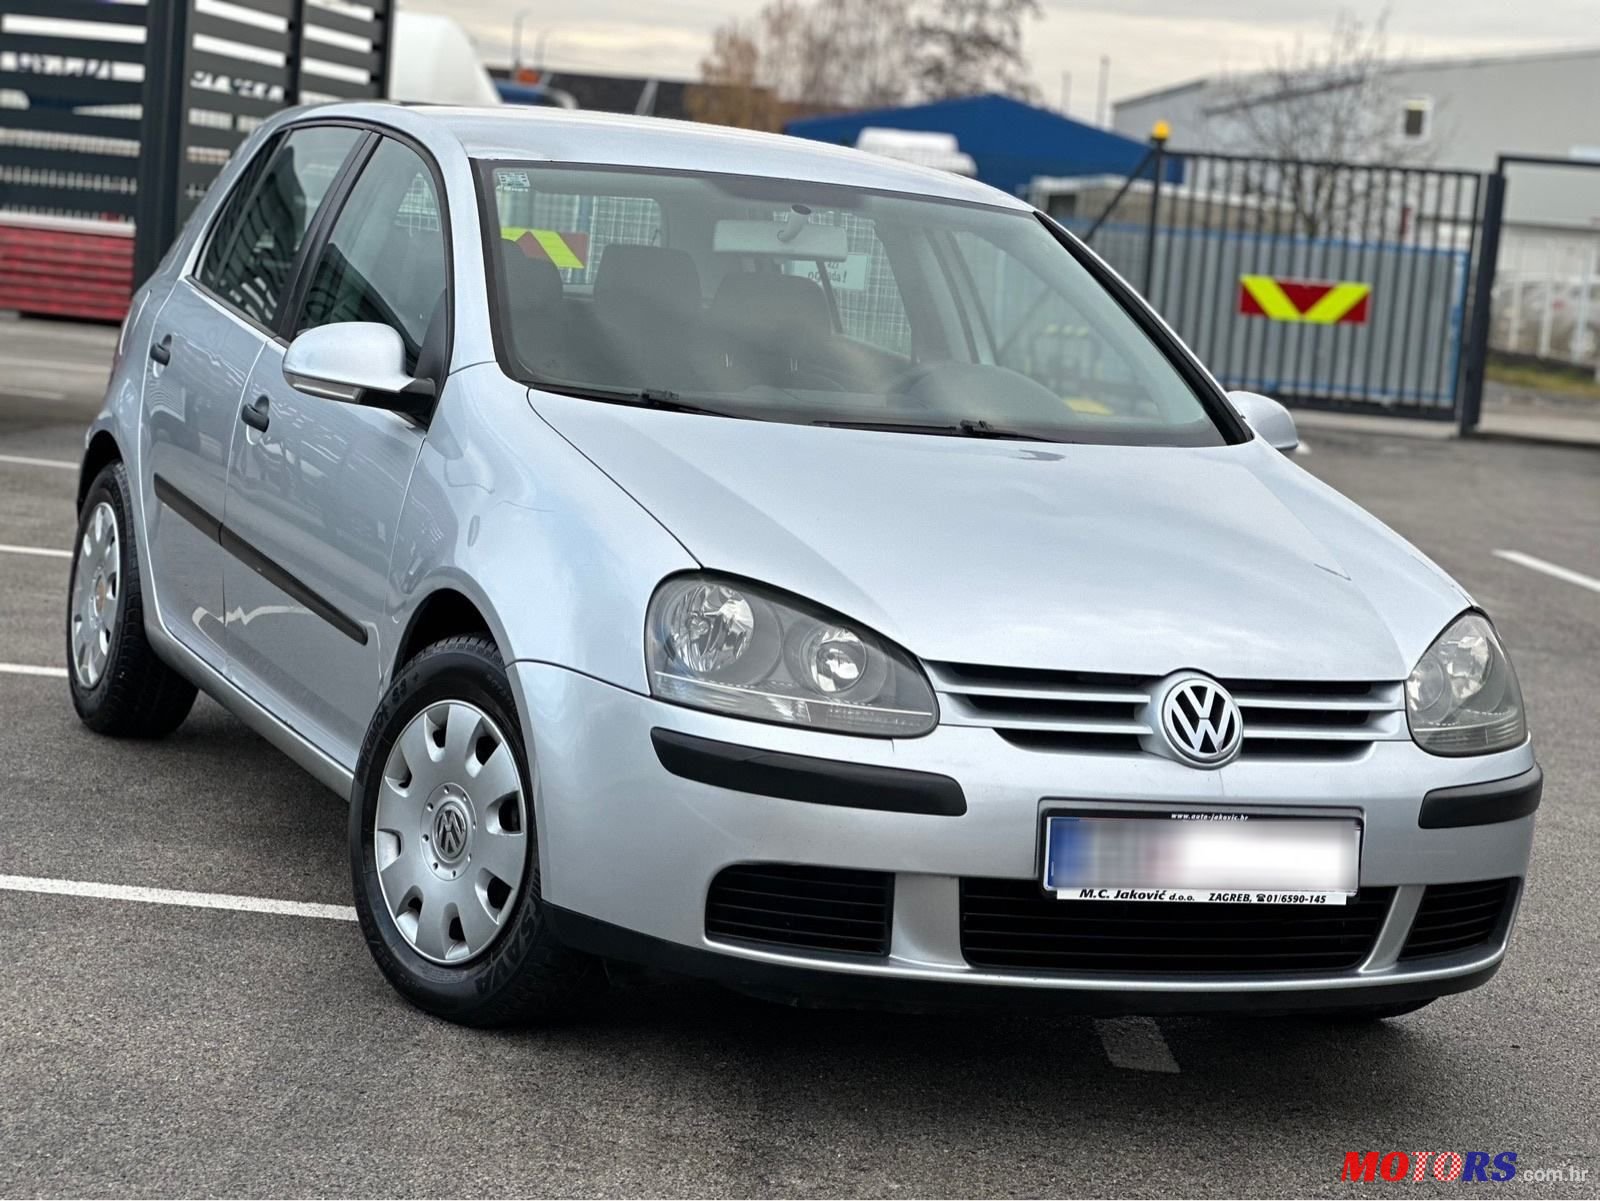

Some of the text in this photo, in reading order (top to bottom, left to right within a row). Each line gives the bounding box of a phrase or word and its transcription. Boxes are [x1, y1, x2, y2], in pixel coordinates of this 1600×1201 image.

[1164, 680, 1241, 758] VW
[1079, 888, 1110, 899] M.C.
[1114, 889, 1167, 900] Jaković
[1168, 892, 1195, 901] d.o.o.
